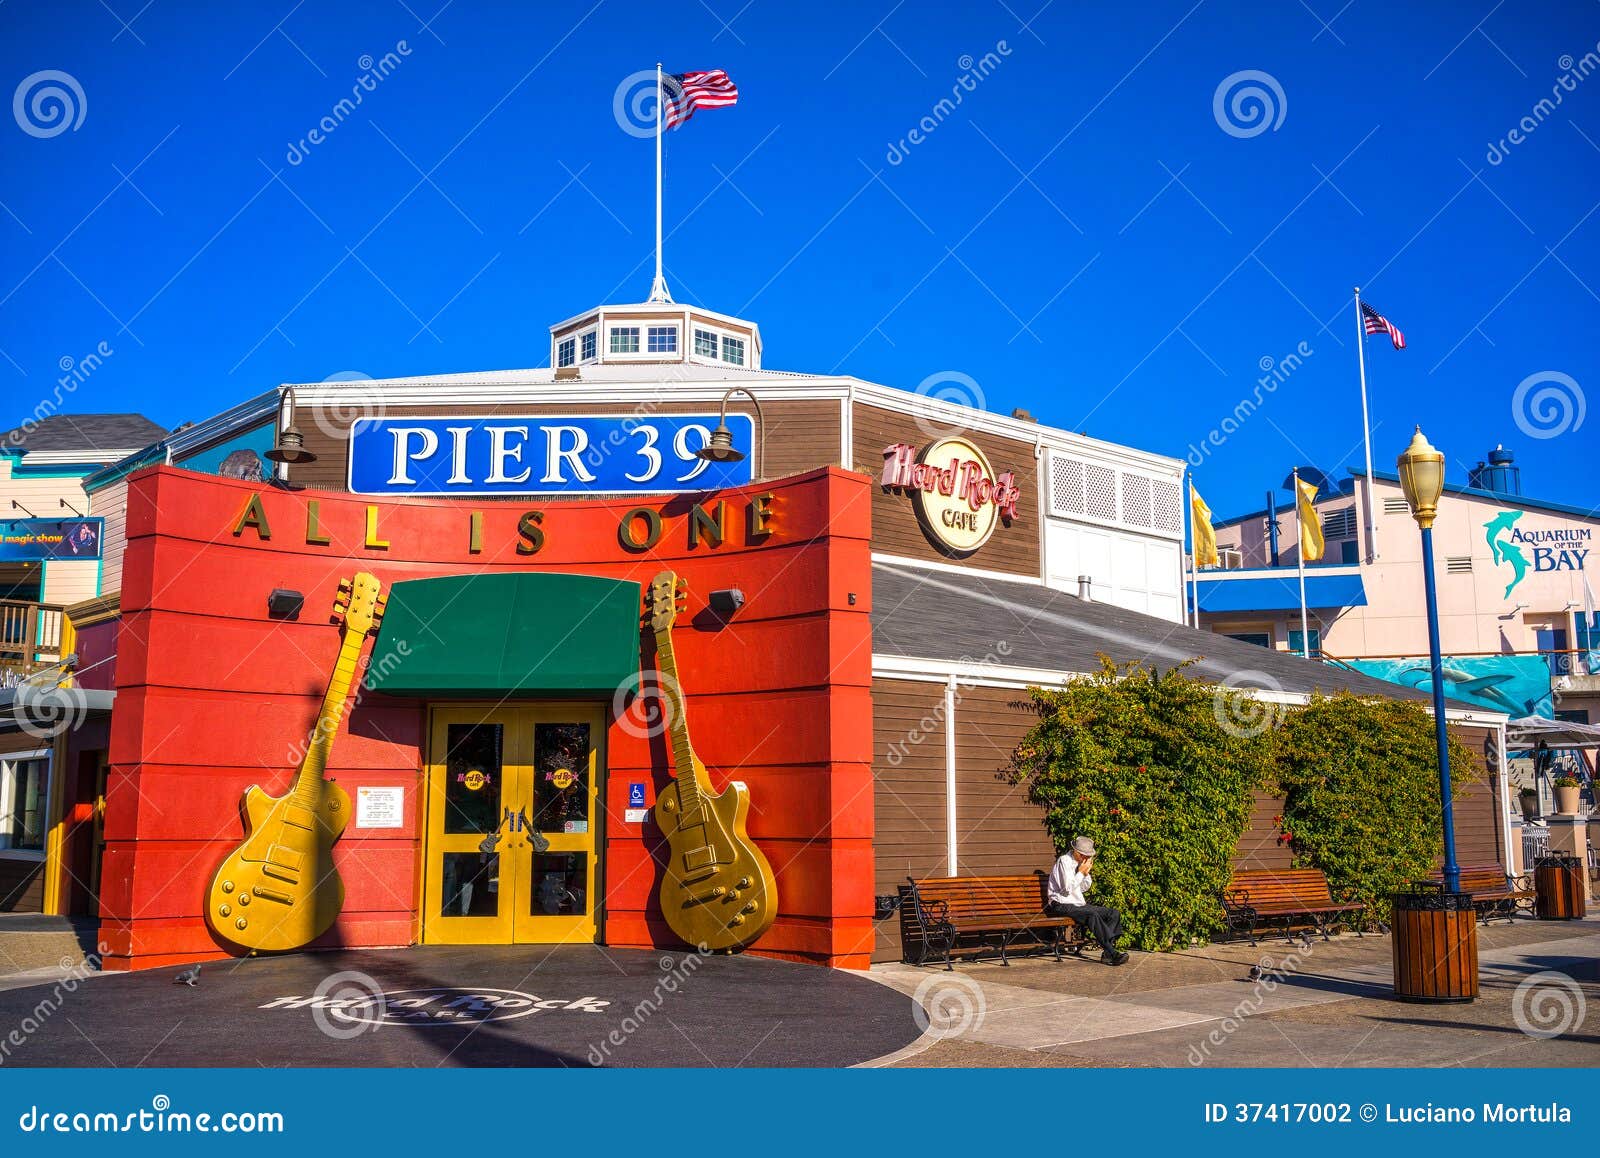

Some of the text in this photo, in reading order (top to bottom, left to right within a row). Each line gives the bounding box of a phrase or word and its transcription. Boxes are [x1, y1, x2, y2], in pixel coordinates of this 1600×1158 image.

[387, 424, 712, 484] PIER 39
[881, 443, 1020, 520] Hard Rock
[5, 534, 34, 546] magic
[36, 533, 63, 543] show
[233, 491, 775, 554] ALL IS ONE
[941, 508, 978, 532] CAFE
[257, 995, 611, 1012] Hard Rock
